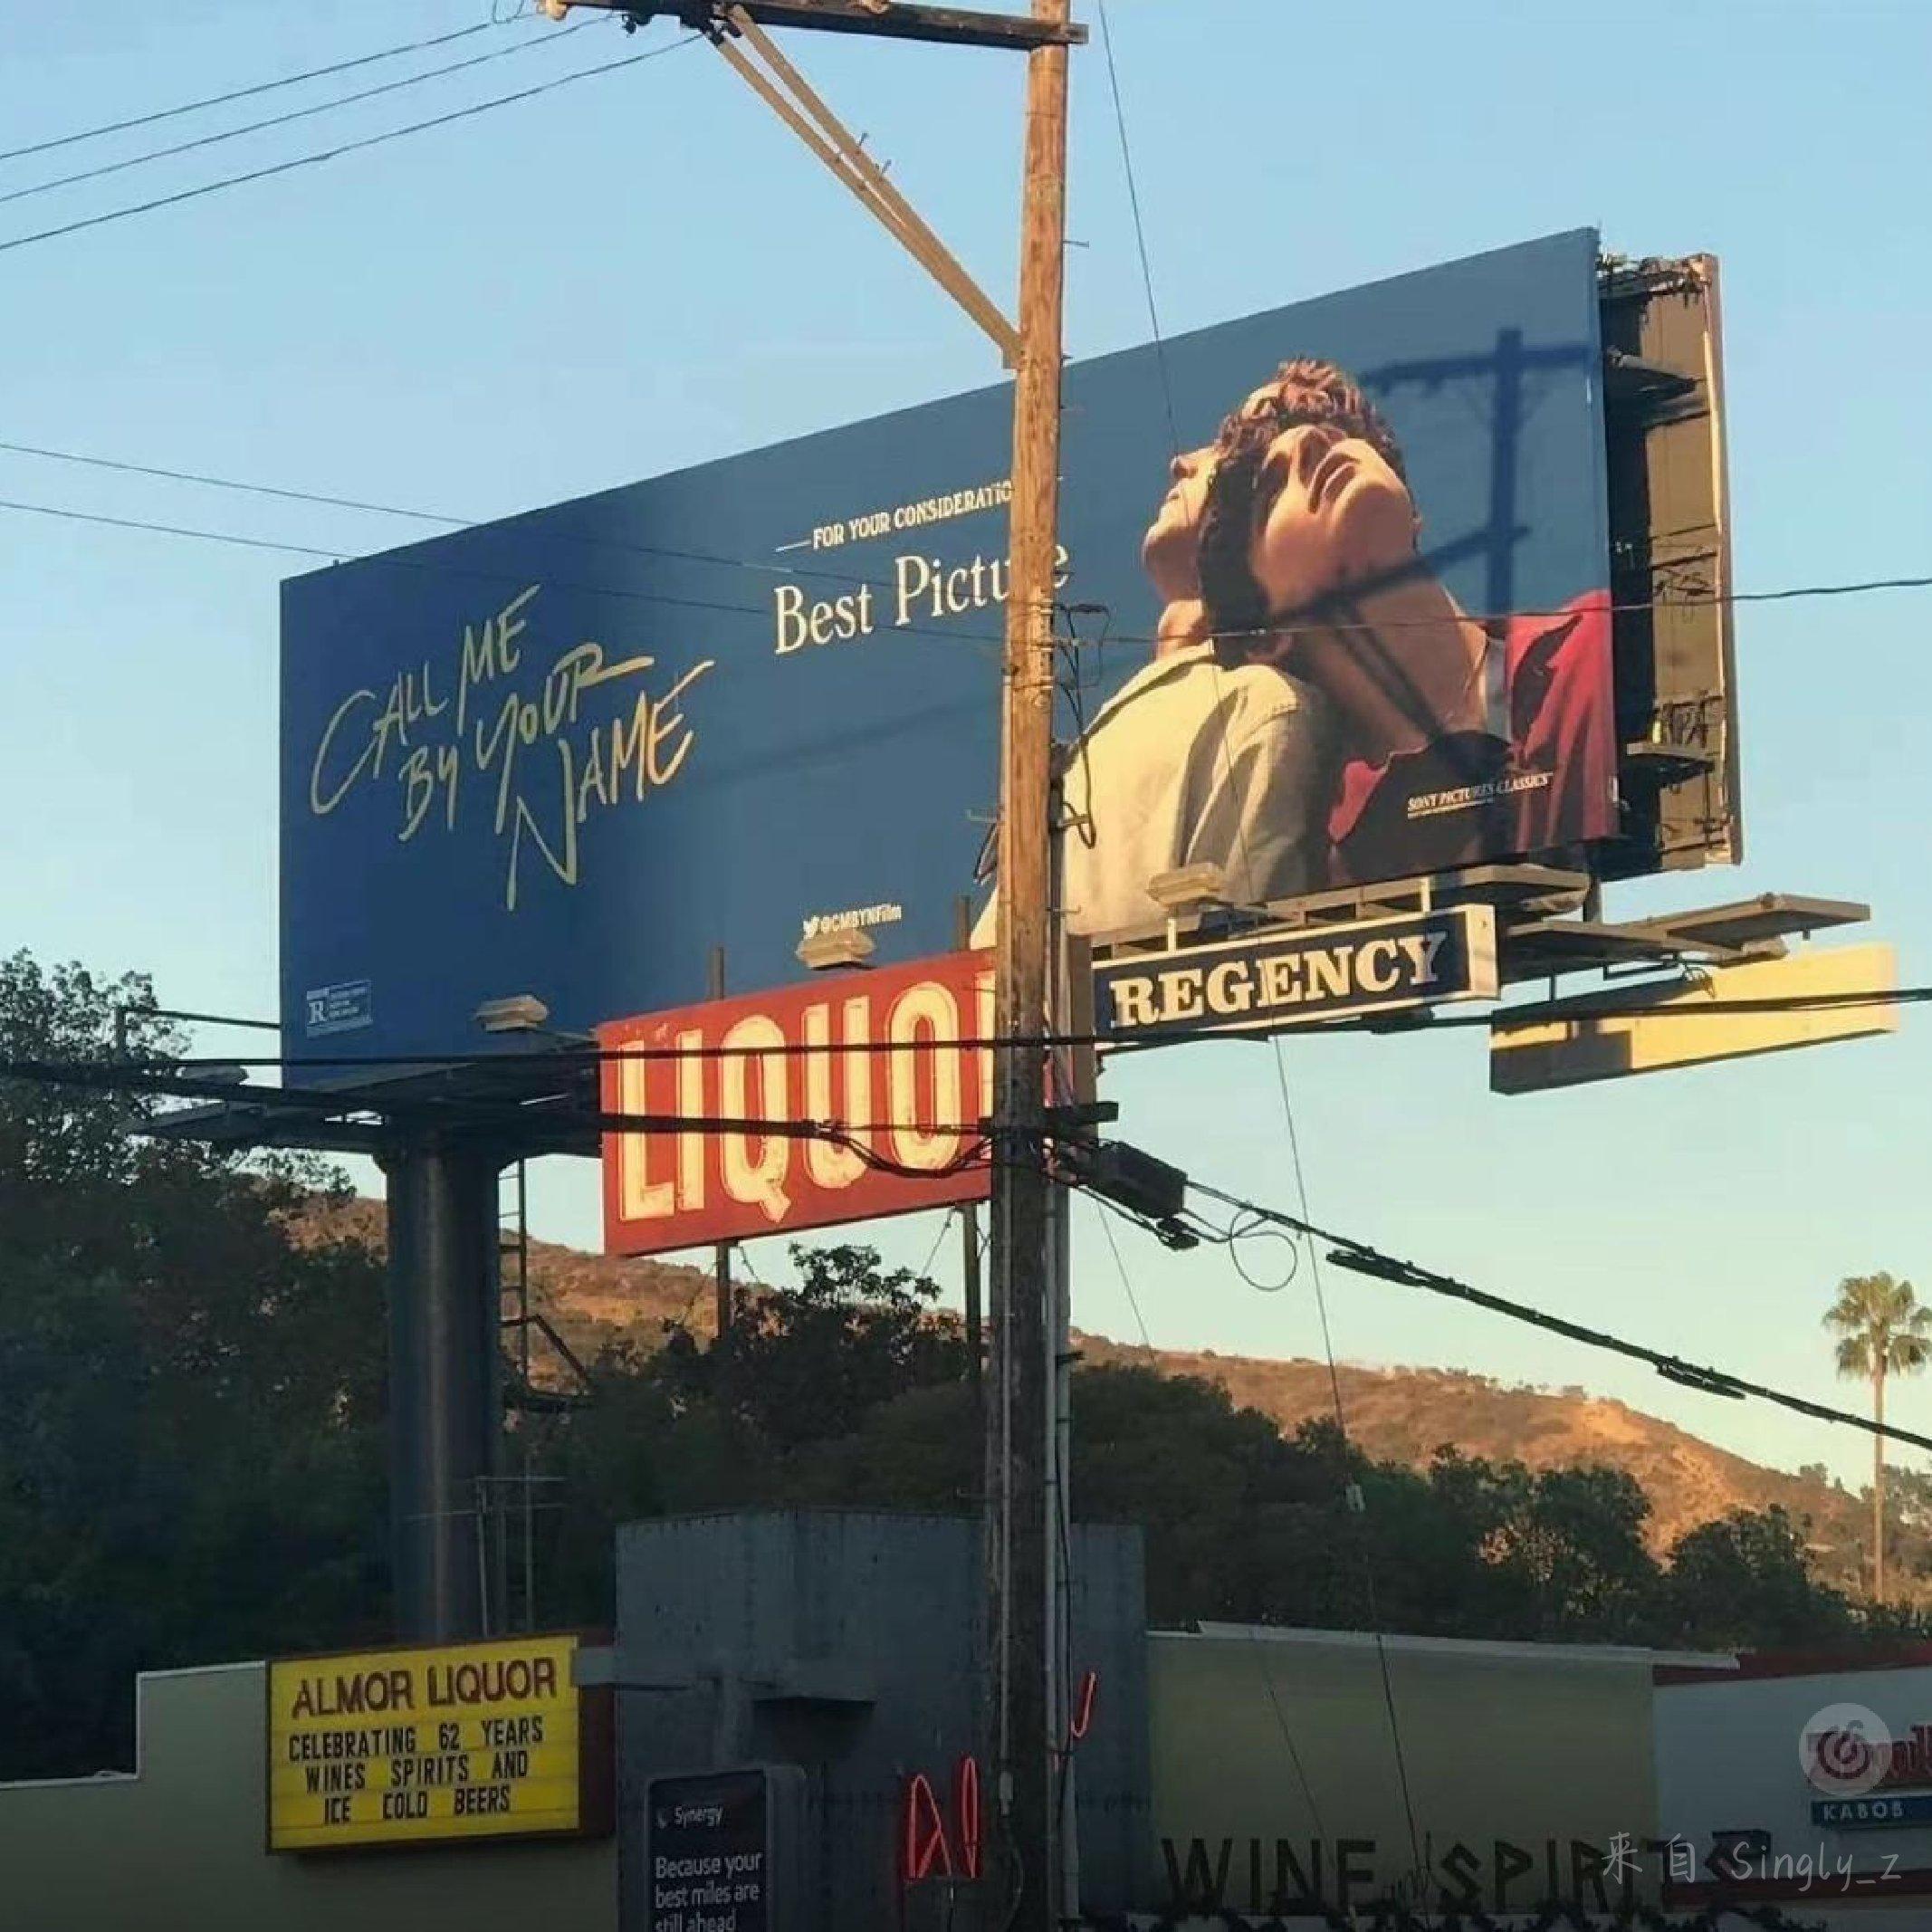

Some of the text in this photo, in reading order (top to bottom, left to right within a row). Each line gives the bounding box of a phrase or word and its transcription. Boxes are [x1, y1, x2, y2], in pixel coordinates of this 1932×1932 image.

[813, 479, 1012, 550] FOR YOUR CONSIDERATIO
[774, 543, 1071, 655] Best Pictue
[311, 584, 541, 815] CALL ME
[398, 642, 655, 842] BY YOUR
[505, 659, 715, 912] NAME
[1109, 932, 1448, 1029] REGENCY
[292, 1657, 558, 1718] ALMOR LIQUOR
[289, 1716, 543, 1762] CELEBRATING 62 YEARS
[306, 1750, 529, 1794] WINES SPIRITS AND
[324, 1785, 512, 1824] ICE COLD BEERS
[1823, 1801, 1904, 1822] KABOB
[655, 1852, 762, 1879] Because your
[655, 1879, 761, 1908] best miles are
[1161, 1838, 1378, 1913] WINE
[686, 1907, 737, 1932] ahead
